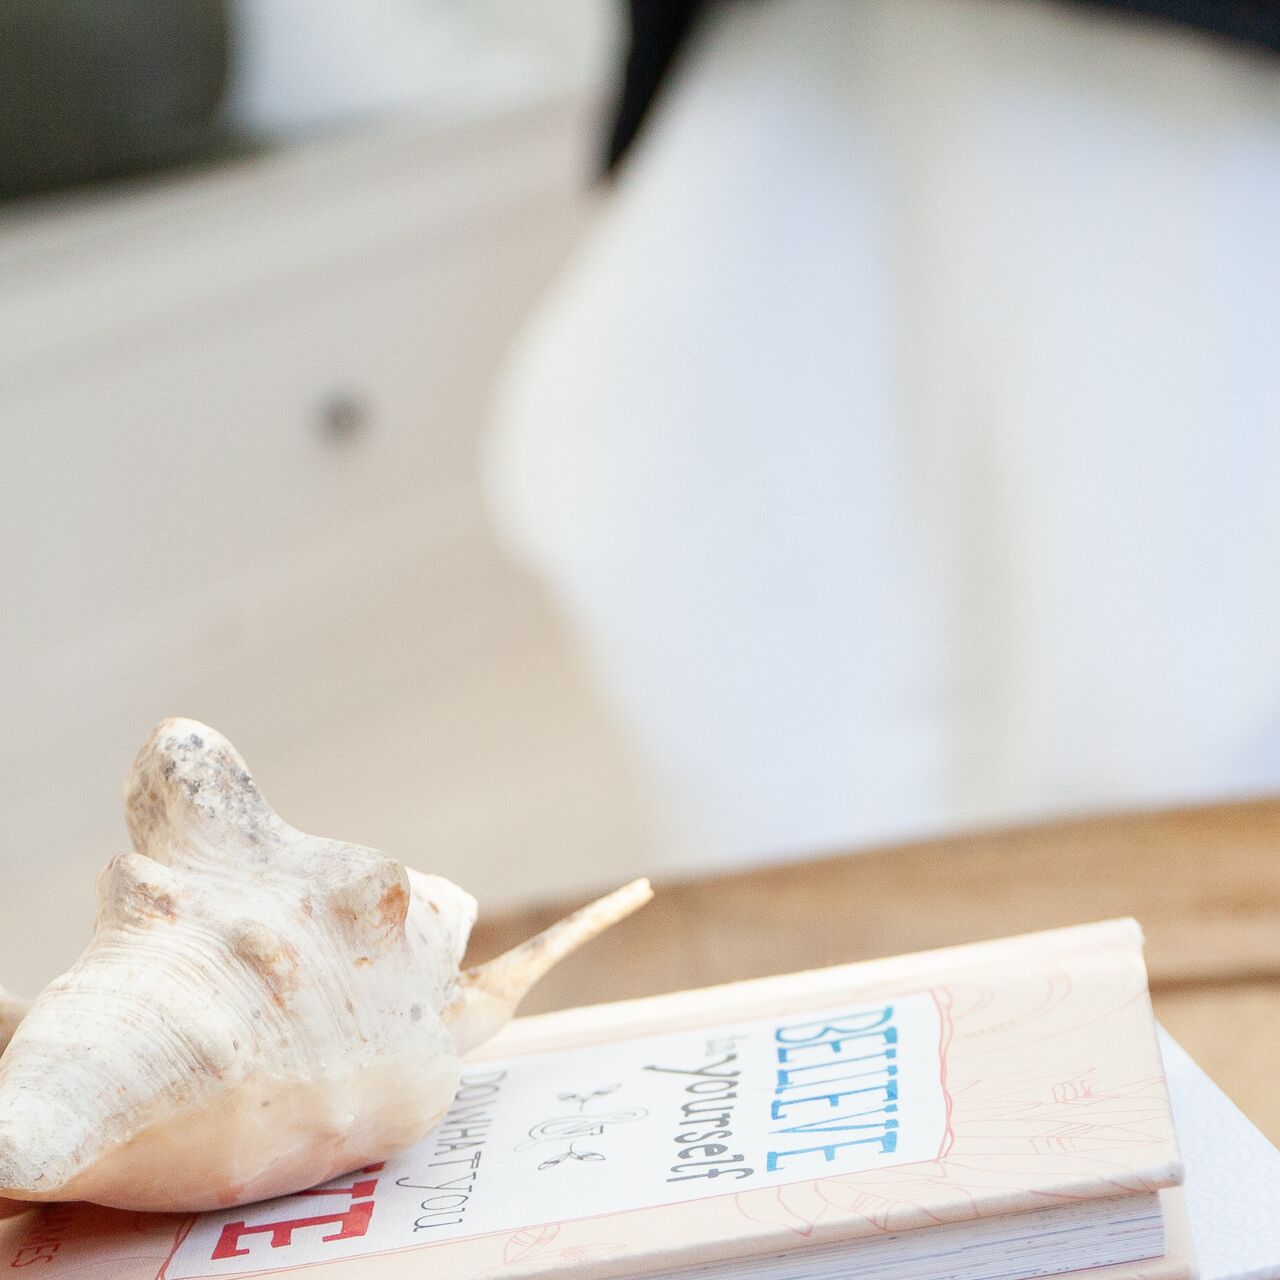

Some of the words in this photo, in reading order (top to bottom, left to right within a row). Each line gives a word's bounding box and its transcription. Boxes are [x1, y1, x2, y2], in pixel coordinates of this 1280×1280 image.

[428, 1099, 497, 1168] WHAT
[642, 1053, 754, 1183] yourself
[766, 1005, 899, 1173] BELIEVE
[396, 1171, 477, 1233] you
